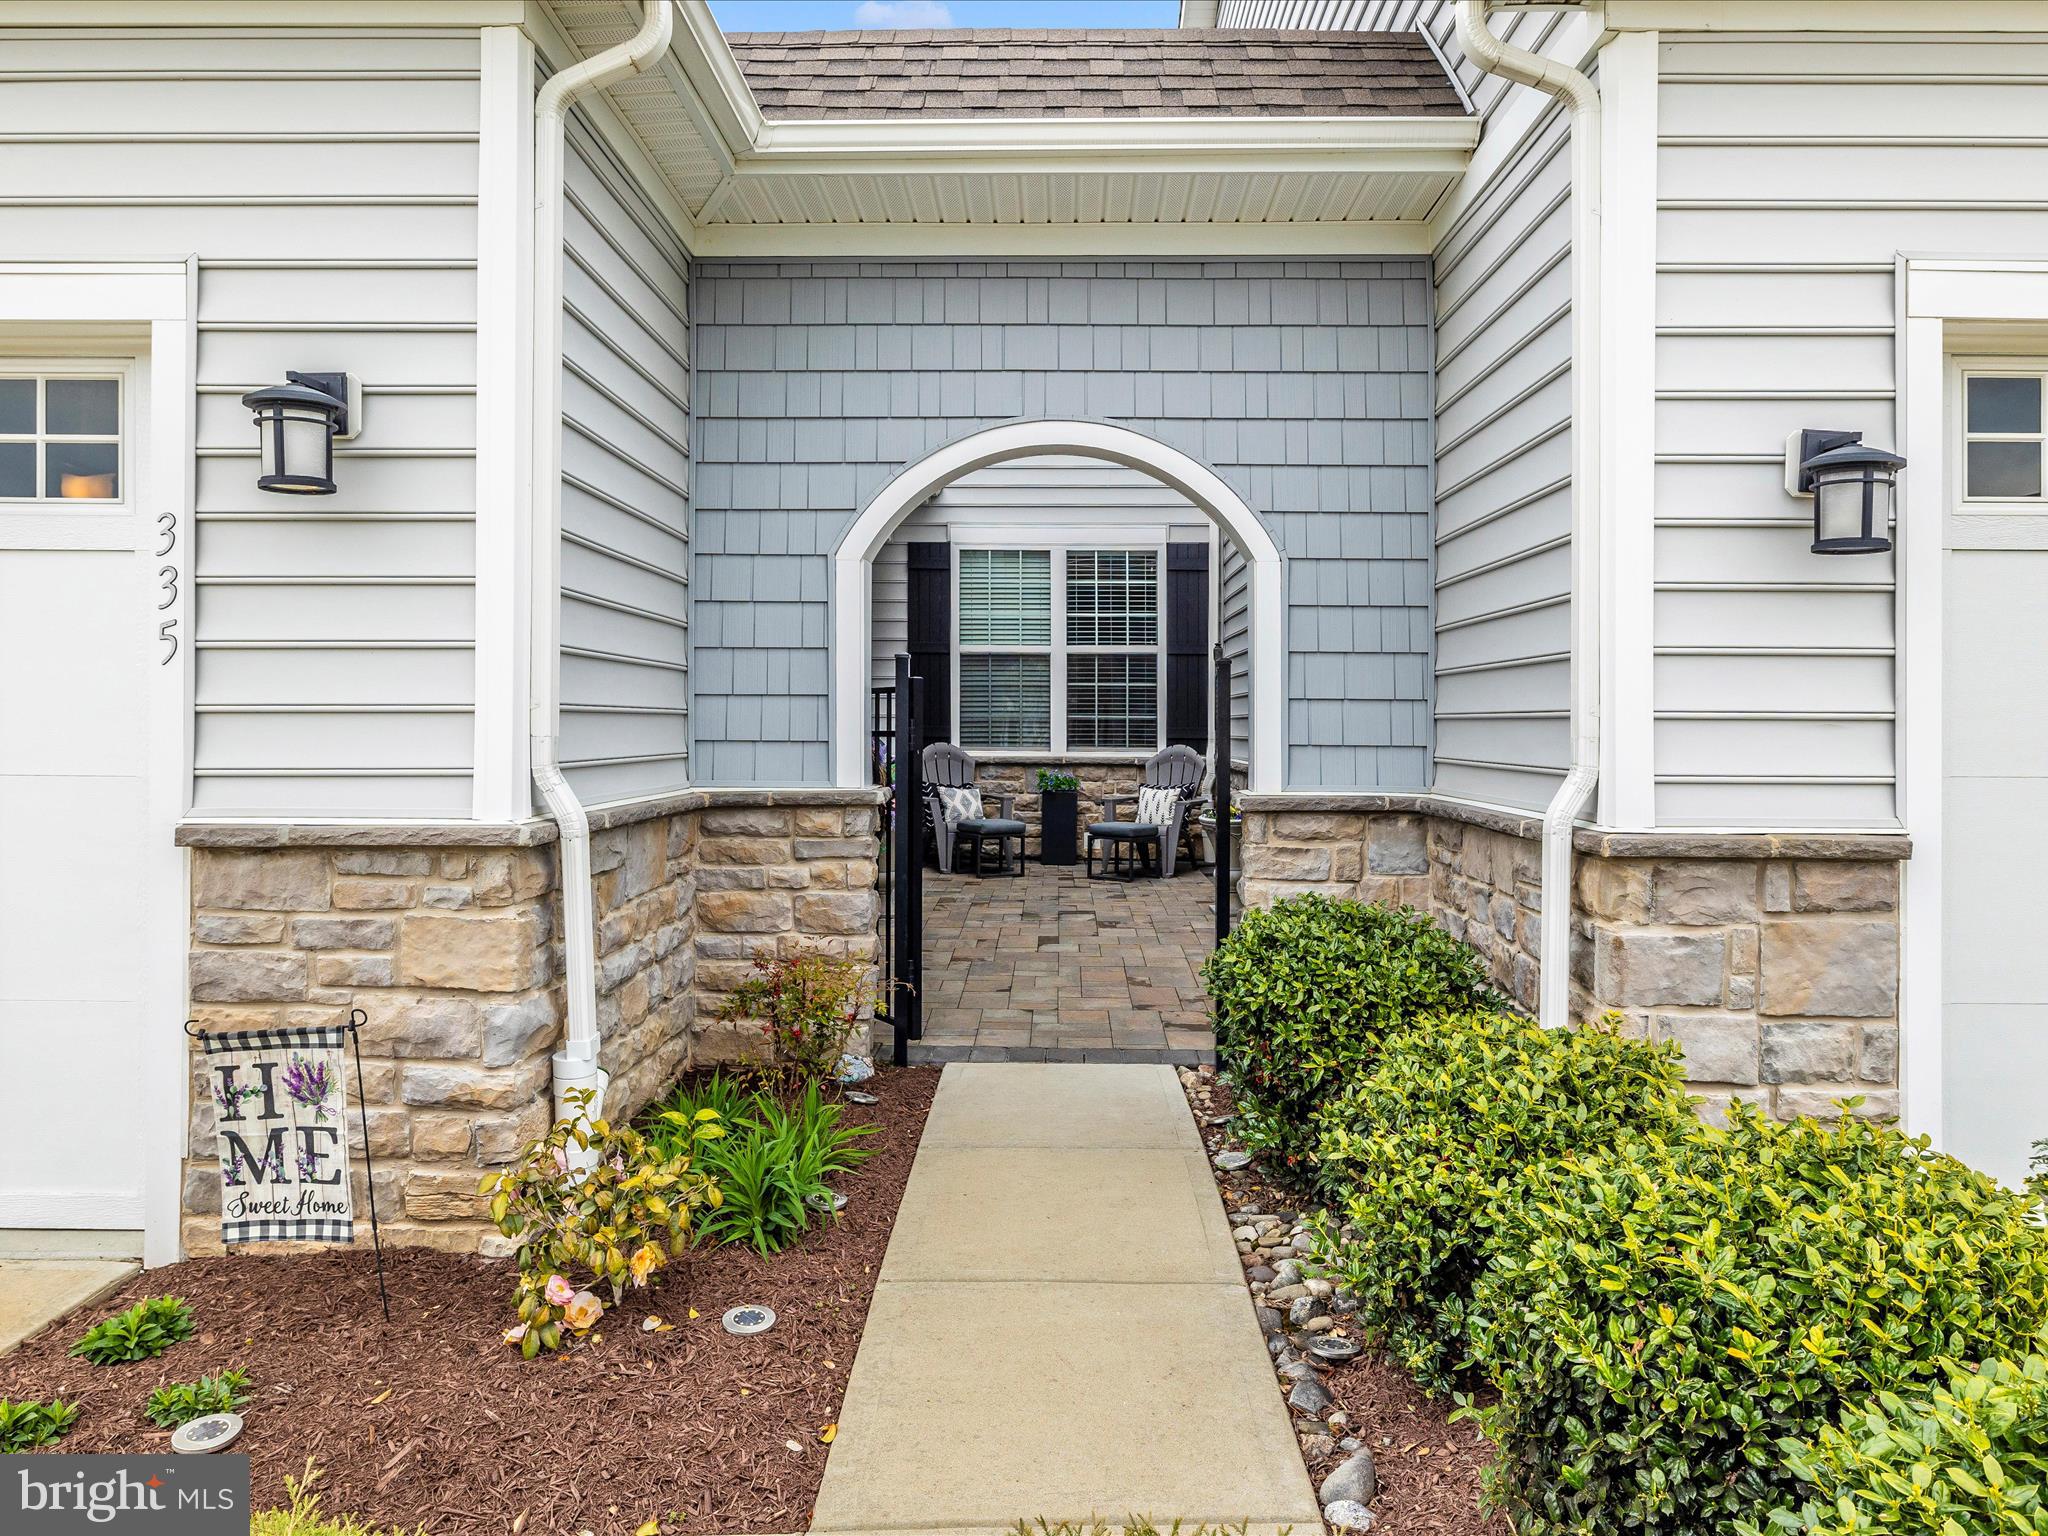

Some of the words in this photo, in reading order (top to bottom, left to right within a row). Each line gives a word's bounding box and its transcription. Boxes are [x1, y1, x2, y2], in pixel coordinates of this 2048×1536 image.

[155, 511, 178, 666] 335
[227, 1191, 290, 1218] Sweet
[293, 1189, 348, 1216] Home
